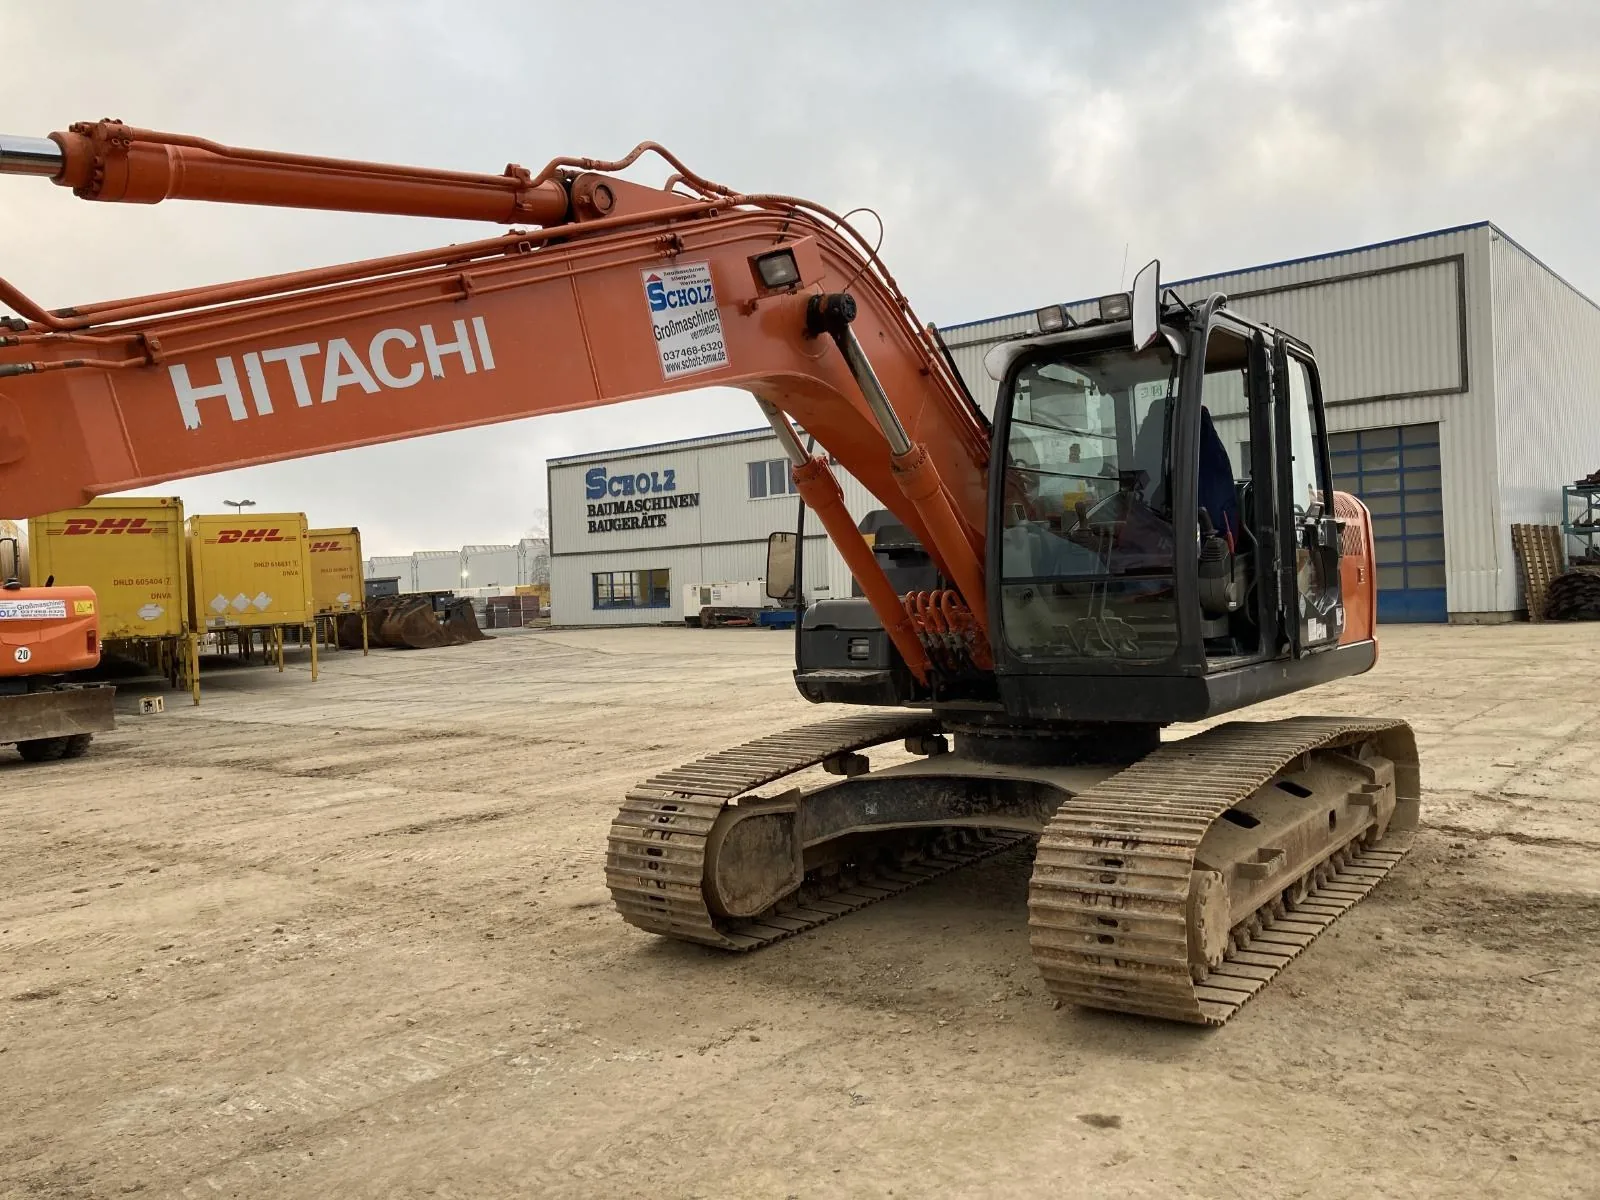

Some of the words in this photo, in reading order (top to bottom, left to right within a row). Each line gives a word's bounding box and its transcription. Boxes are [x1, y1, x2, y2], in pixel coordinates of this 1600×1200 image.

[653, 307, 721, 341] Großmaschinen
[690, 323, 721, 341] vermietung
[663, 341, 723, 361] 037468-6320
[665, 349, 726, 374] www.scholz-bmw.de
[168, 315, 495, 431] HITACHI
[587, 492, 700, 517] BAUMASCHINEN
[63, 518, 153, 535] DHL
[587, 512, 667, 534] BAUGERÄTE
[217, 528, 284, 544] DHL
[308, 541, 343, 553] HL
[113, 578, 134, 586] DHLD
[135, 577, 163, 586] 605404
[151, 592, 172, 600] DNVA
[17, 649, 29, 660] 20
